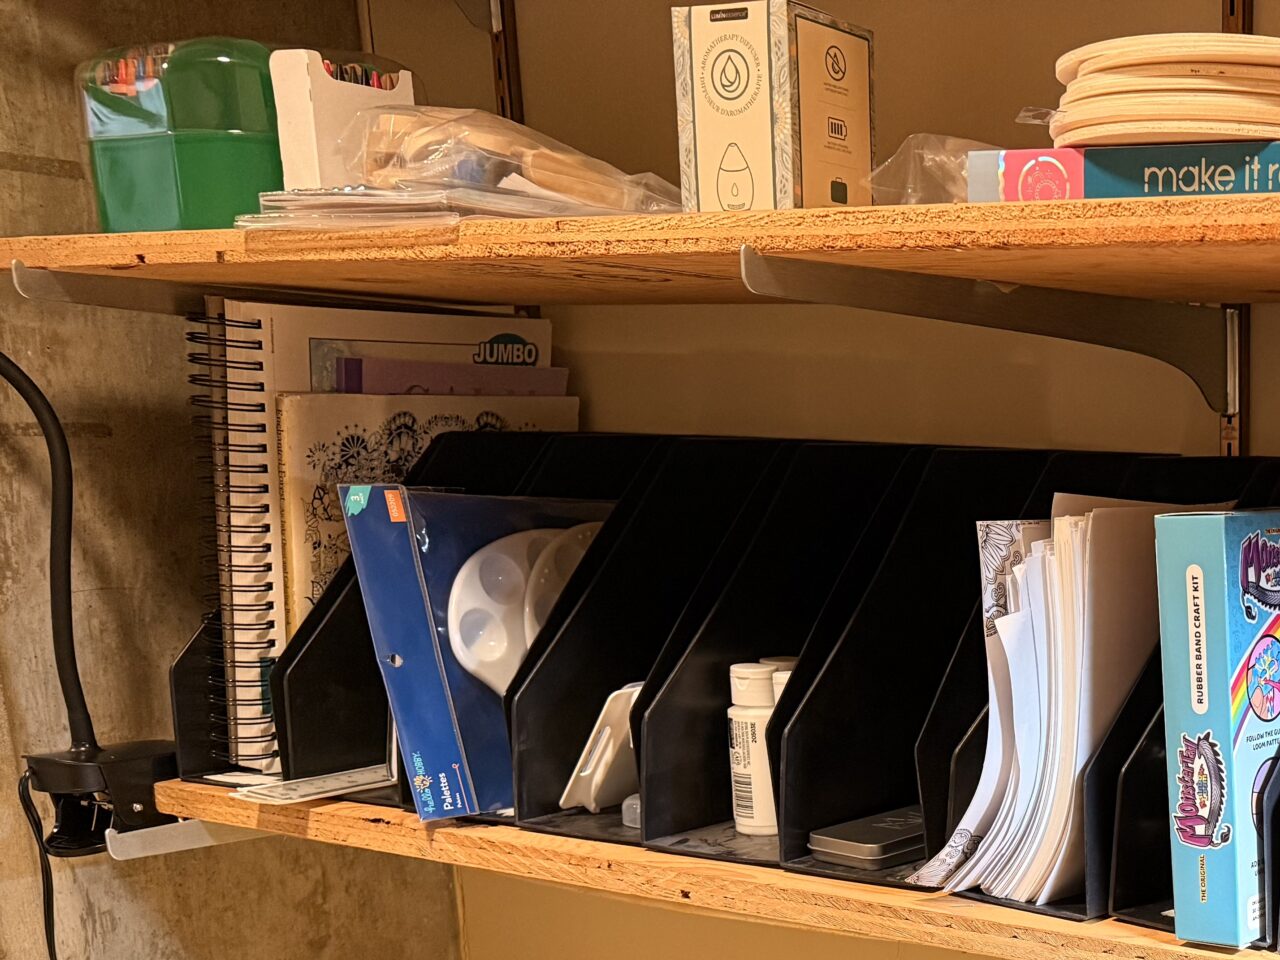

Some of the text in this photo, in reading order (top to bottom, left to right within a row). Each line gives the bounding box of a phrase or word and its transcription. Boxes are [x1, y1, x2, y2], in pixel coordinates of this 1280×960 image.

[1144, 157, 1235, 193] make
[1245, 155, 1261, 191] it
[474, 343, 537, 363] JUMBO
[1191, 574, 1204, 705] RUBBER BAND CRAFT KIT
[439, 772, 455, 811] Palettes
